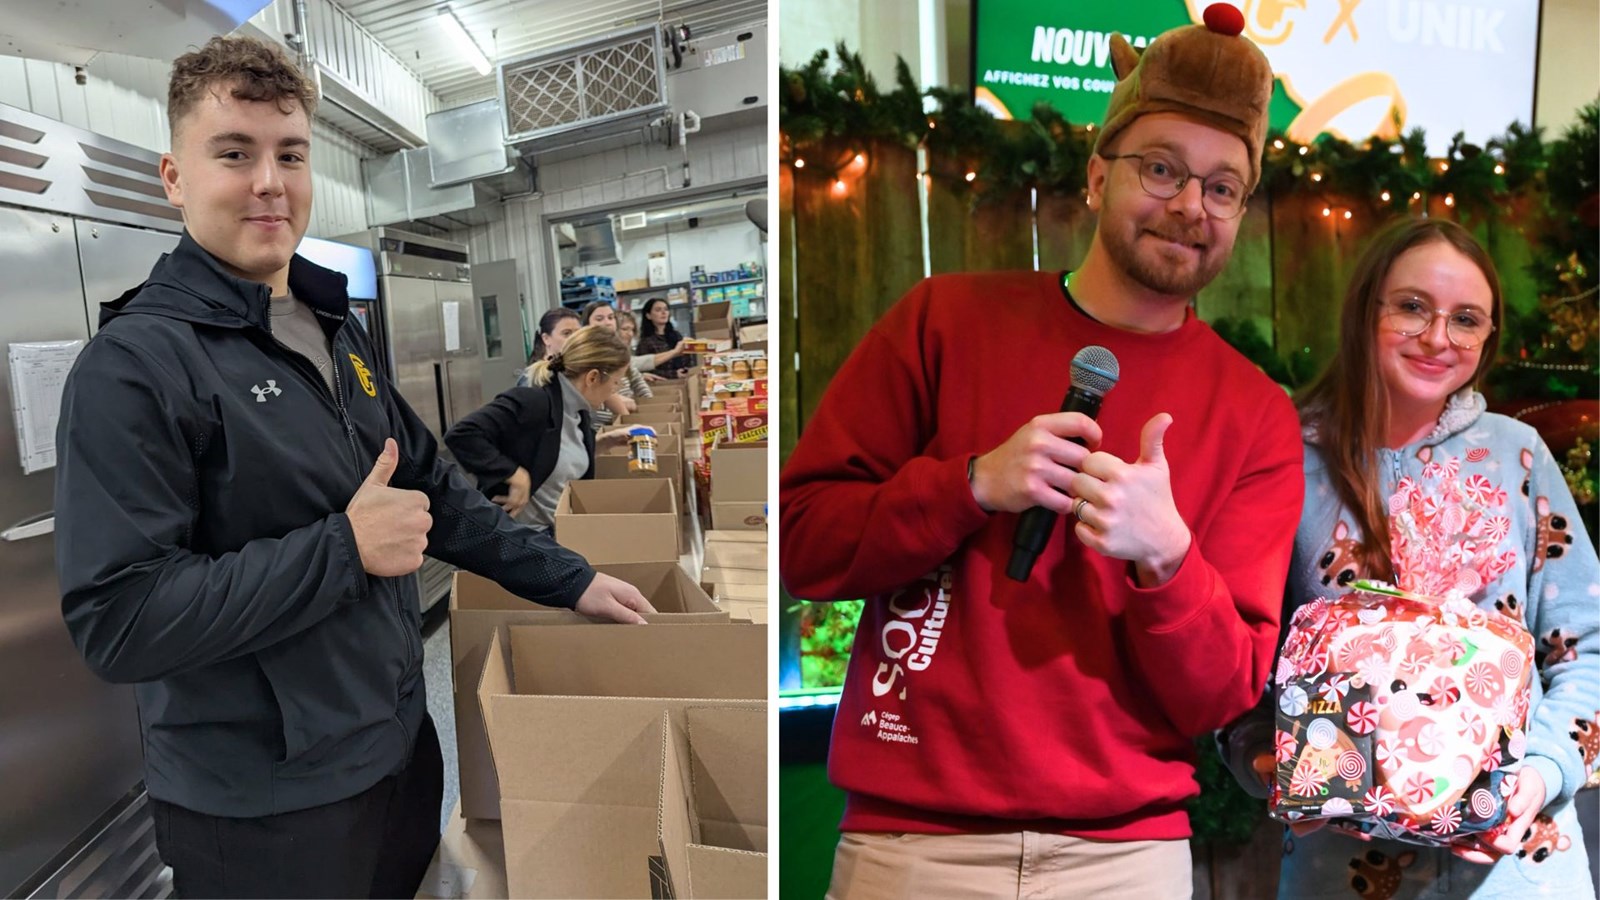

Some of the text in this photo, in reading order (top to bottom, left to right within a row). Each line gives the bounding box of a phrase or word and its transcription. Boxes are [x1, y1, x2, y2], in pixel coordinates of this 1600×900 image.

[1387, 0, 1506, 53] UNIK
[1031, 26, 1156, 69] NOUV
[983, 70, 1049, 88] AFFICHEZ
[1052, 75, 1080, 91] VOS
[1303, 700, 1342, 714] PIZZA
[879, 719, 911, 732] Beauce-
[877, 729, 919, 744] Appalaches
